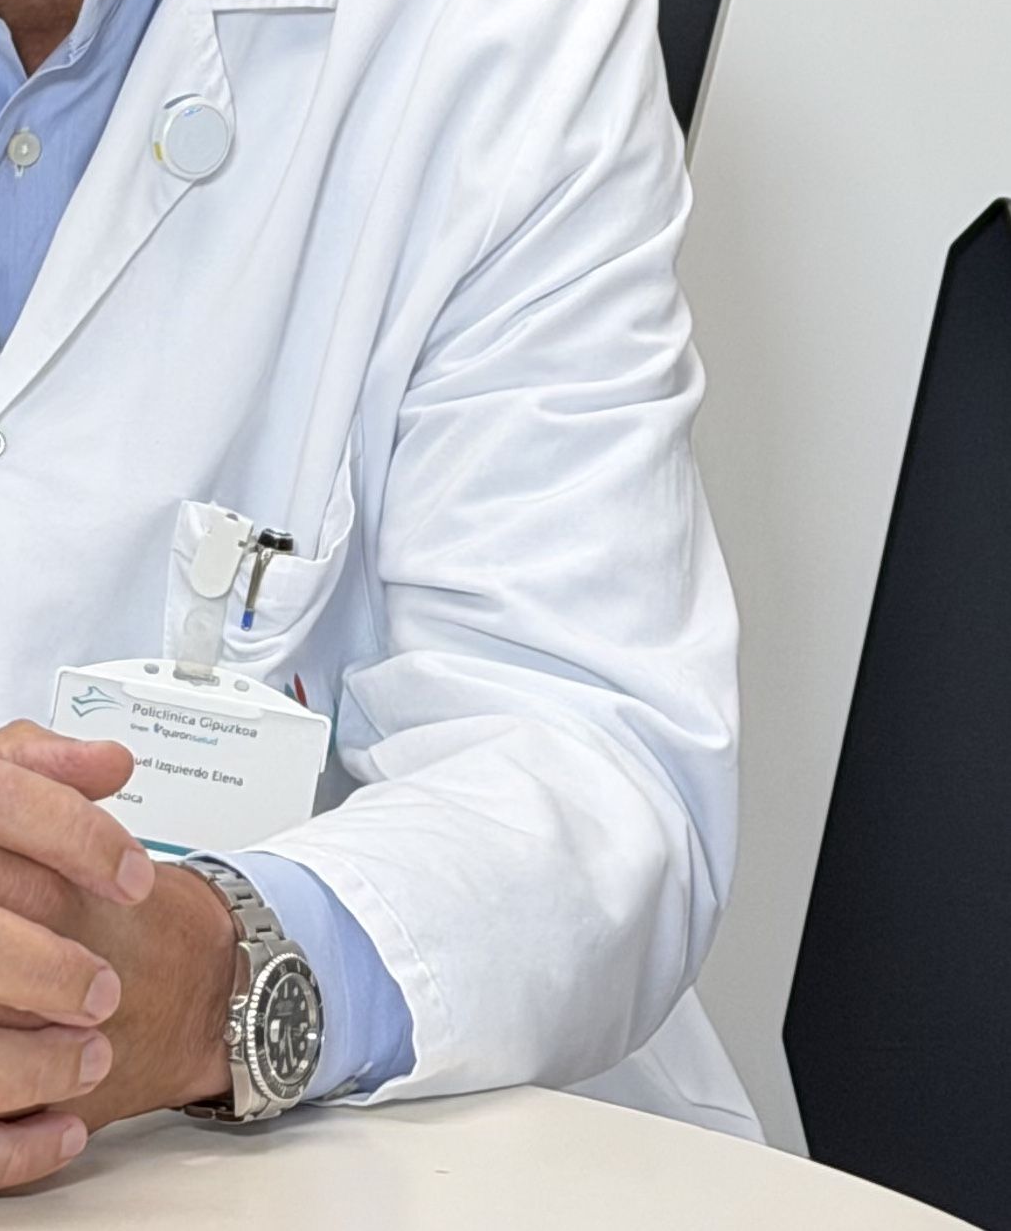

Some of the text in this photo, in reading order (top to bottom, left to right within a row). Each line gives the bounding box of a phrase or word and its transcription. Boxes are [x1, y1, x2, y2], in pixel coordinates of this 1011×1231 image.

[199, 716, 258, 738] Gipuzkoa
[134, 757, 244, 786] uel Izquierdo Elena
